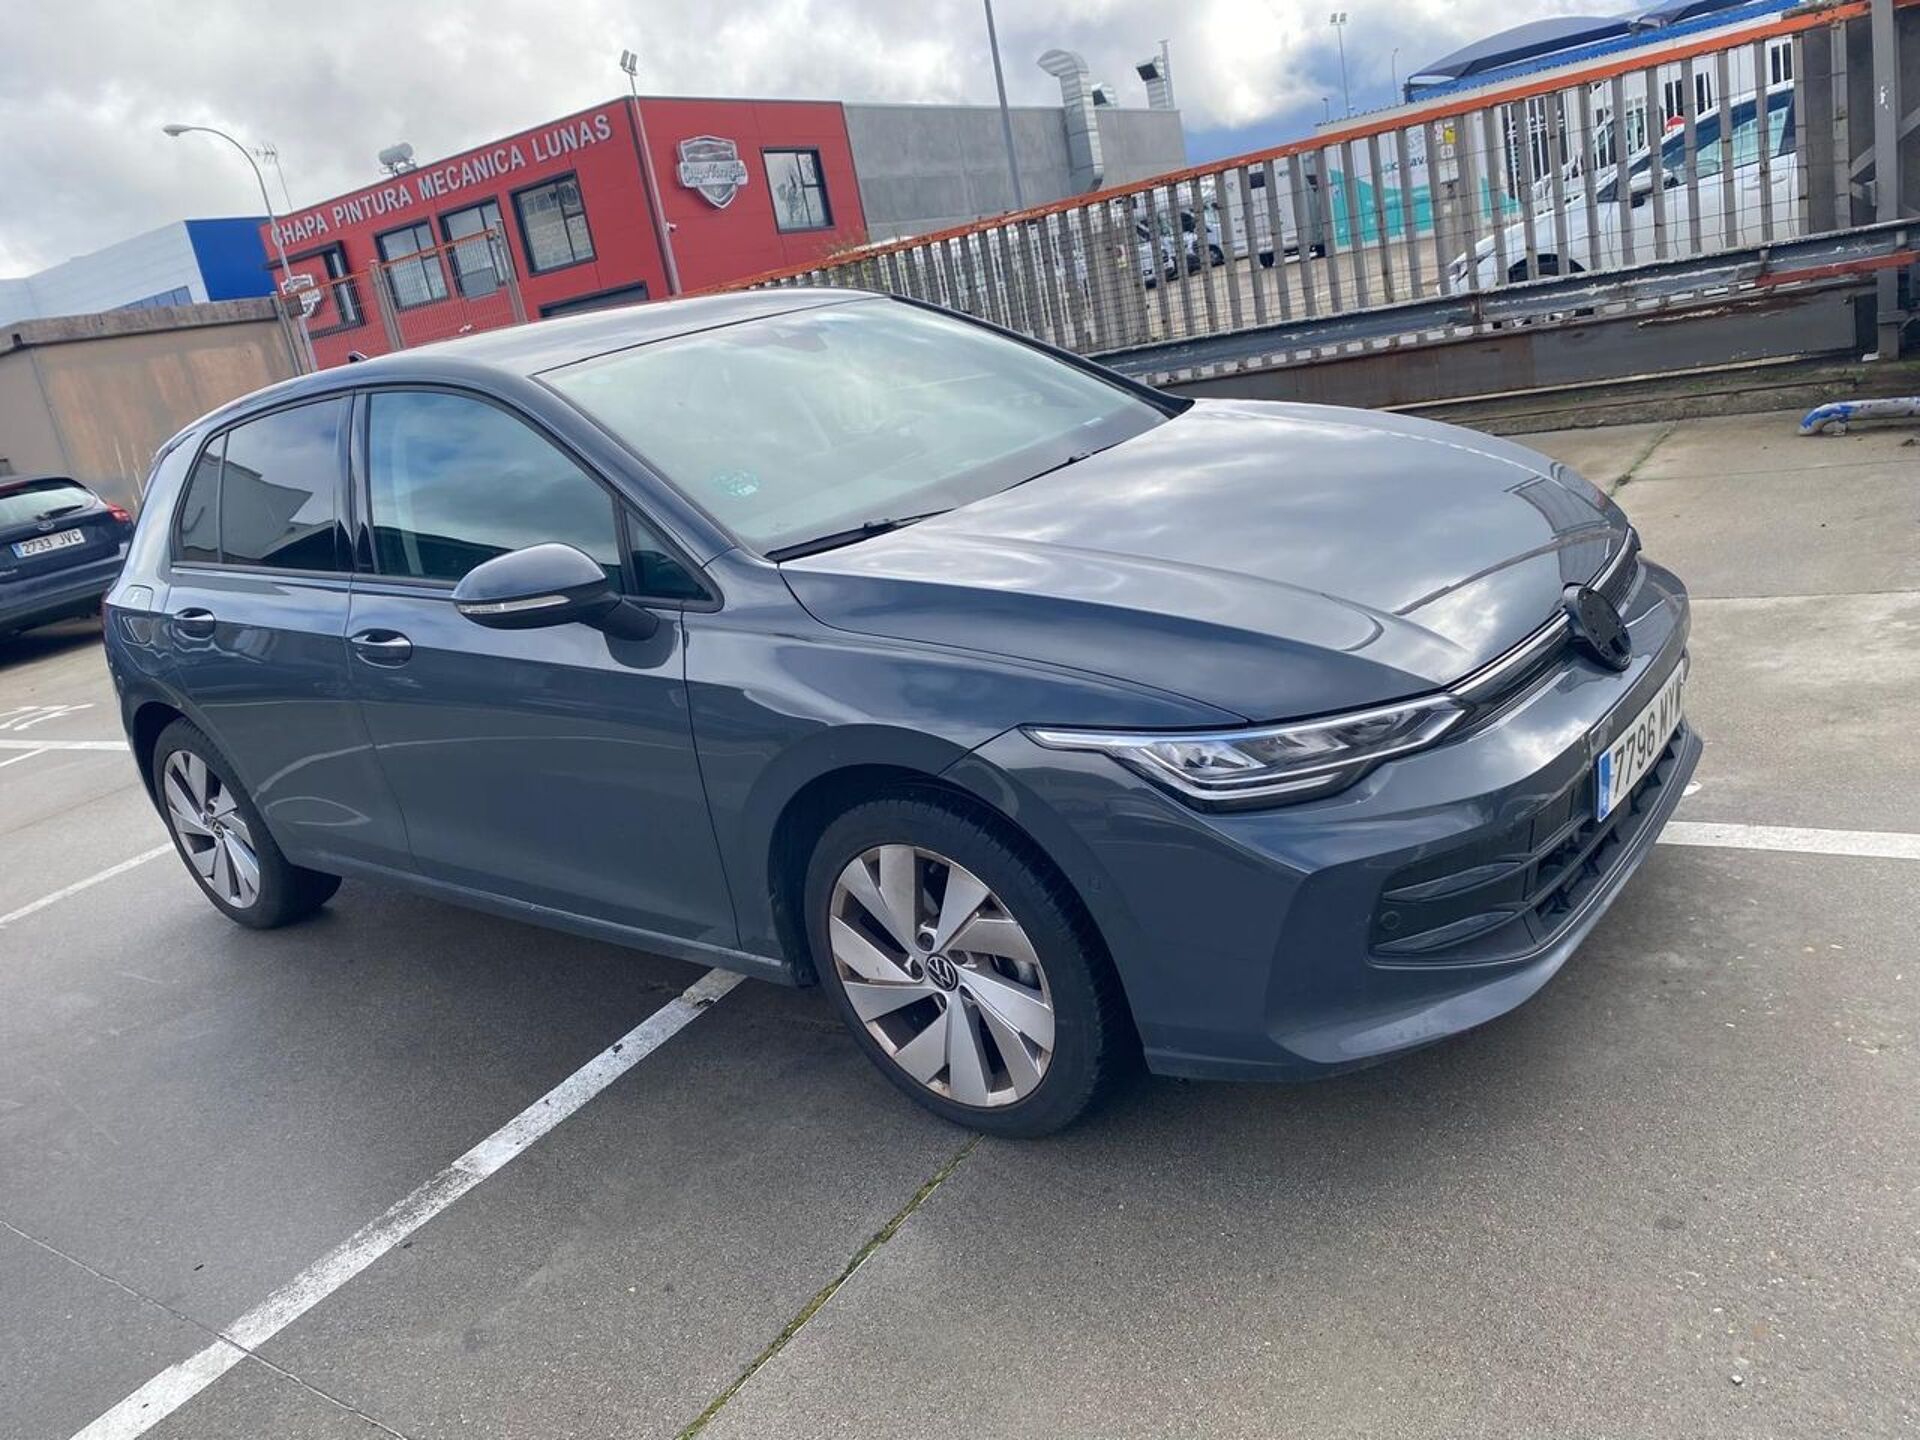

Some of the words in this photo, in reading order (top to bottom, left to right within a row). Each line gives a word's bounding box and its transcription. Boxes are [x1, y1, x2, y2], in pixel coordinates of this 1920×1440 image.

[332, 184, 412, 227] PINTURA
[417, 146, 525, 200] MECANICA
[531, 114, 611, 161] LUNAS
[1614, 711, 1655, 799] 7796
